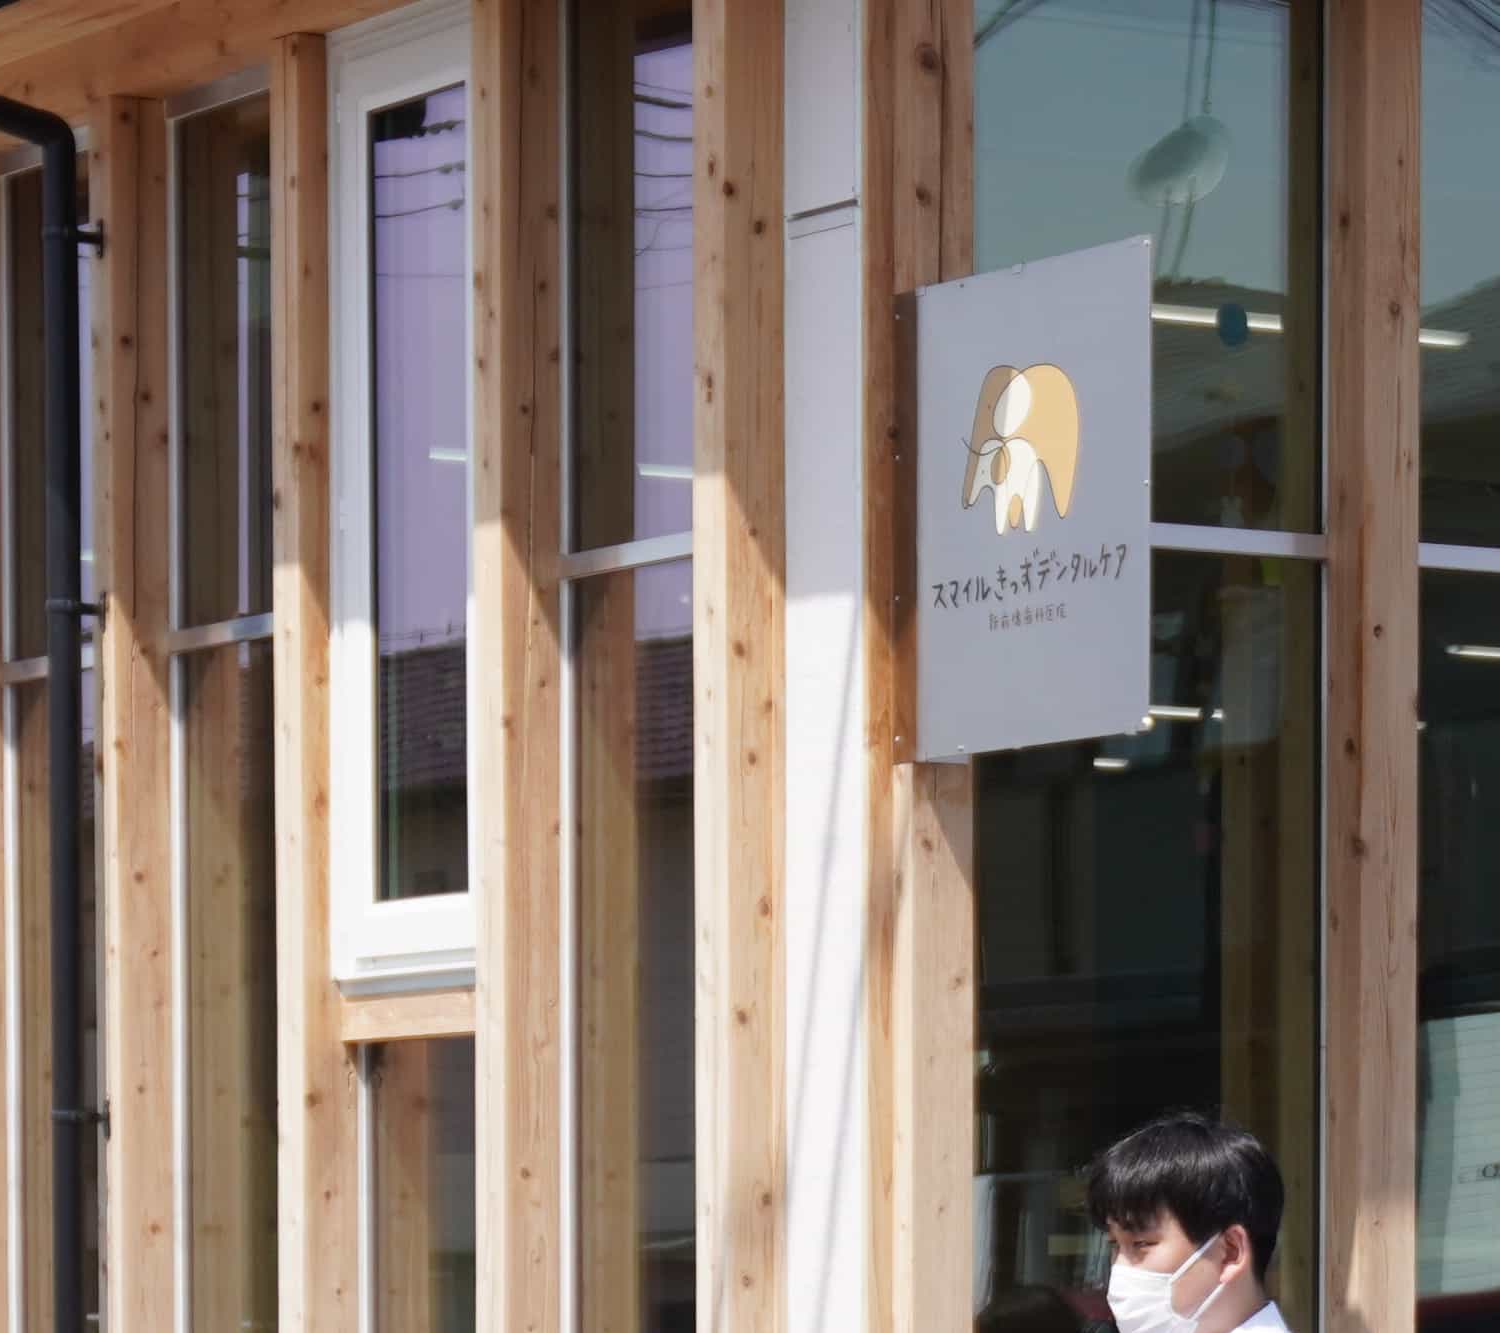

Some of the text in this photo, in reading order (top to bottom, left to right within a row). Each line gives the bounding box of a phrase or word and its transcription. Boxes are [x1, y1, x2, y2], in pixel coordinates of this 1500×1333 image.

[932, 543, 1127, 609] スマイルきっずデンタルケア
